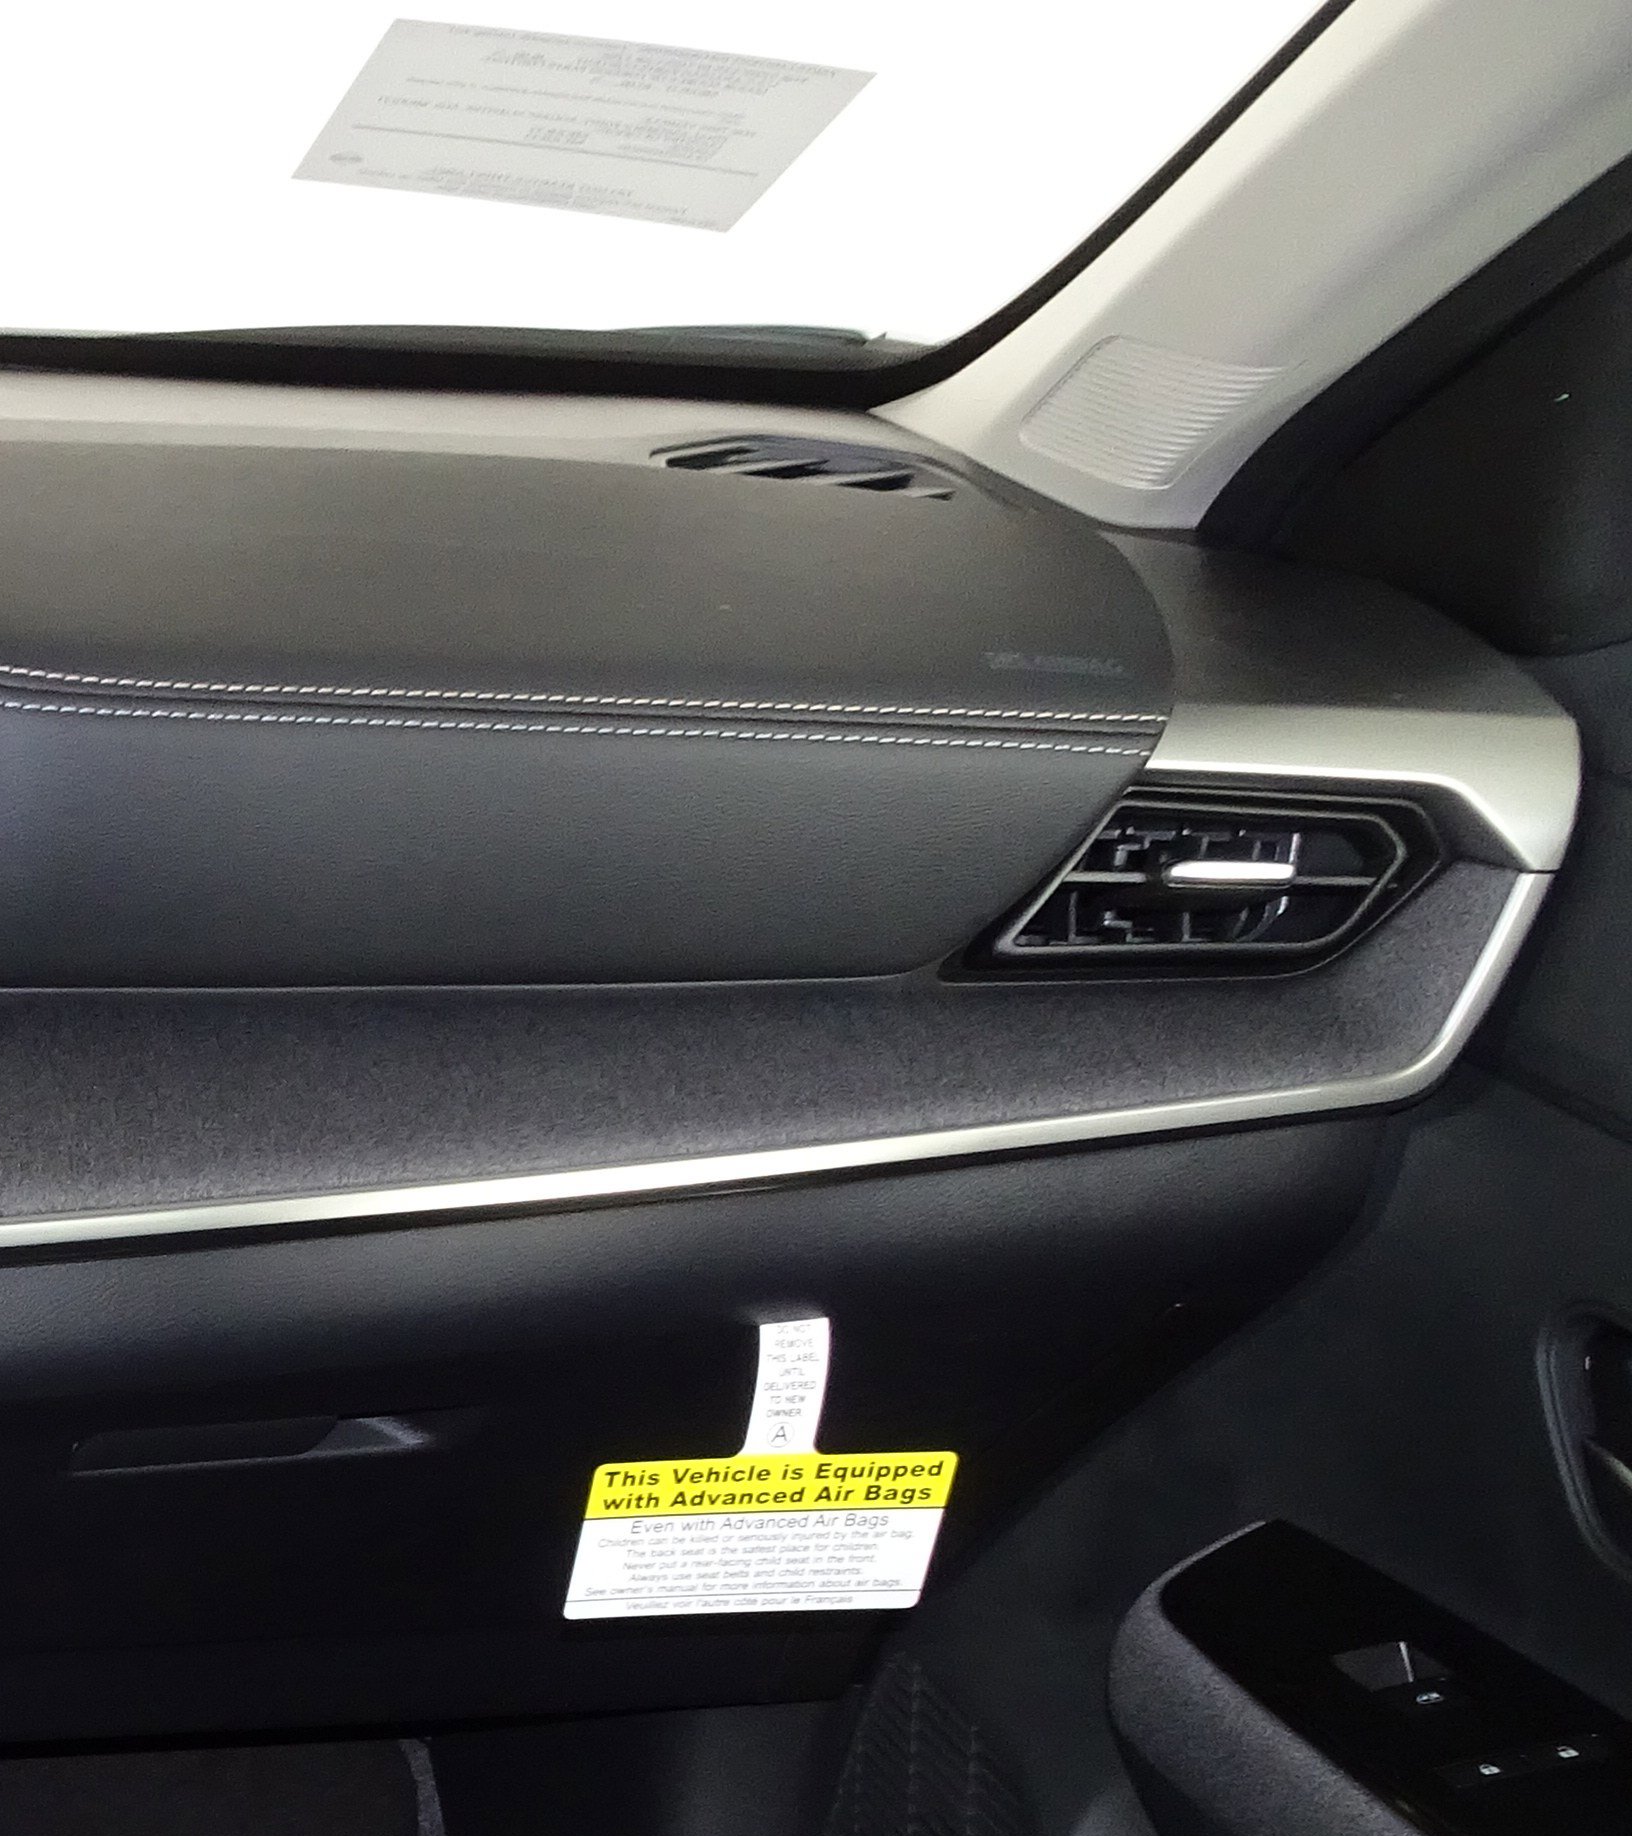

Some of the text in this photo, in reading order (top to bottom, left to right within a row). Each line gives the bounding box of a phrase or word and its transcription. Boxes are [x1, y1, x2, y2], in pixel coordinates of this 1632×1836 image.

[774, 1338, 814, 1348] REMOVE
[766, 1352, 820, 1363] THIS LABEL
[779, 1367, 806, 1377] UNTIL
[763, 1380, 817, 1391] DELIVERED
[770, 1394, 806, 1404] TO NEW
[766, 1408, 803, 1418] OWNER
[770, 1424, 788, 1443] A
[604, 1460, 945, 1488] This Vehicle is Equipped
[603, 1484, 933, 1510] with Advanced Air Bags
[631, 1512, 890, 1535] Even with Advanced Air Bags
[597, 1536, 645, 1548] Children
[648, 1537, 668, 1546] can
[672, 1535, 687, 1545] be
[689, 1534, 719, 1544] killed
[722, 1534, 735, 1543] or
[738, 1531, 787, 1543] seriously
[791, 1531, 830, 1542] injured
[832, 1530, 848, 1541] by
[851, 1530, 869, 1539] the
[872, 1529, 888, 1538] air
[626, 1549, 646, 1558] The
[650, 1547, 675, 1557] back
[680, 1547, 705, 1556] seat
[720, 1546, 738, 1555] the
[742, 1544, 775, 1554] safest
[778, 1544, 811, 1555] place
[814, 1543, 828, 1553] for
[622, 1561, 656, 1571] Never
[658, 1560, 678, 1570] put
[690, 1558, 751, 1569] rear-facing
[754, 1556, 782, 1566] child
[785, 1555, 810, 1565] seat
[827, 1554, 845, 1564] the
[628, 1572, 668, 1583] Always
[672, 1572, 692, 1581] use
[695, 1571, 721, 1580] seat
[723, 1569, 750, 1579] belts
[753, 1568, 775, 1578] and
[778, 1567, 805, 1577] child
[584, 1587, 607, 1597] See
[609, 1584, 653, 1595] owner's
[657, 1583, 699, 1593] manual
[701, 1582, 717, 1592] for
[719, 1582, 749, 1591] more
[752, 1579, 815, 1589] information
[818, 1578, 852, 1588] about
[854, 1578, 870, 1587] air
[761, 1597, 788, 1607] pour
